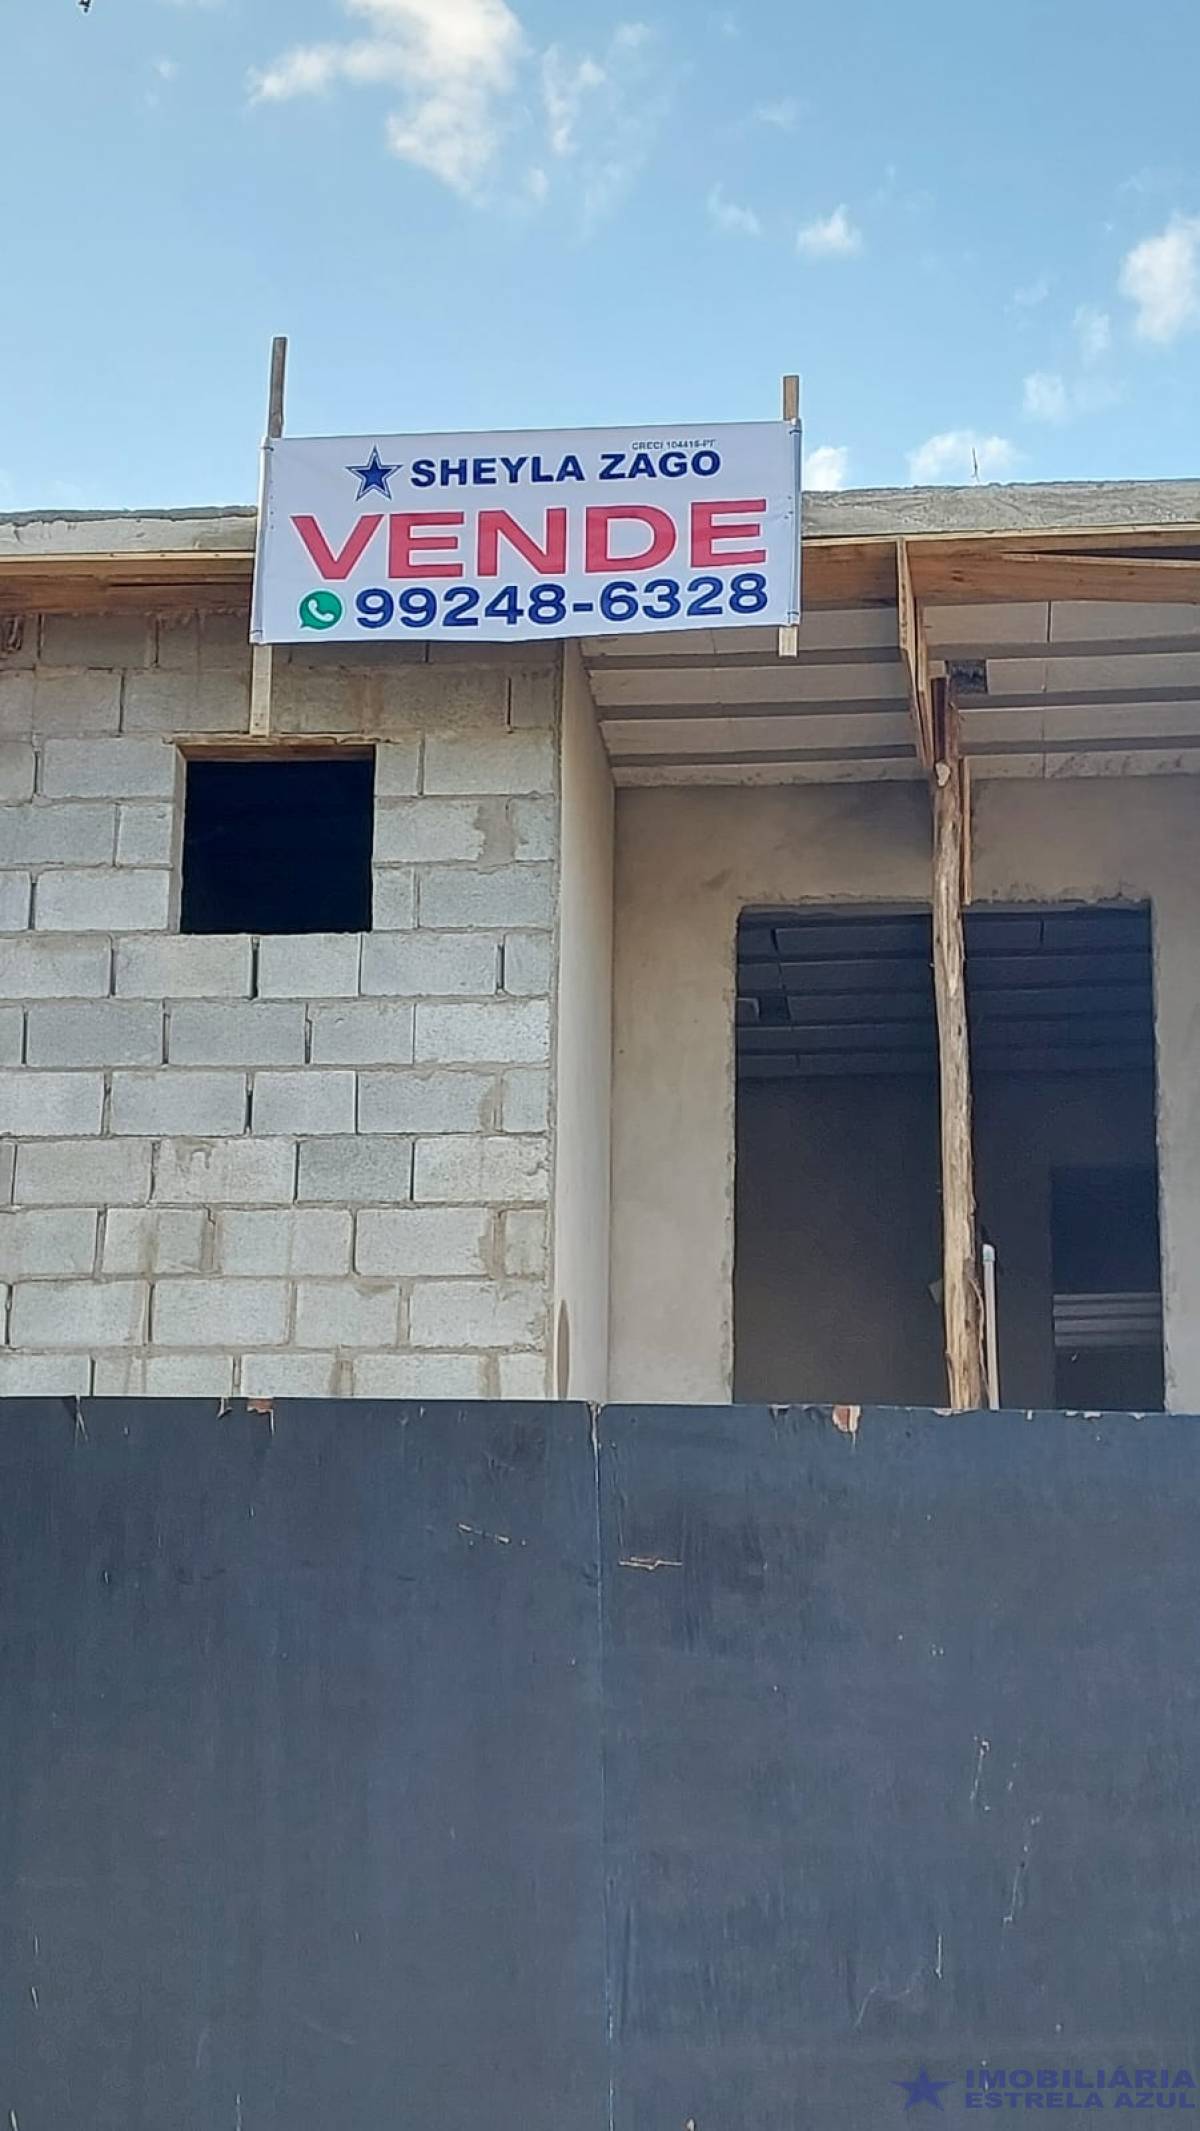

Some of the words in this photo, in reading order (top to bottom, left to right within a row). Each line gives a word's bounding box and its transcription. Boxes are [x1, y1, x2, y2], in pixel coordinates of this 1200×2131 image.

[410, 456, 588, 487] SHEYLA
[599, 450, 721, 480] ZAGO
[632, 441, 663, 450] CRECI
[290, 499, 767, 580] VENDE
[355, 573, 768, 628] 99248-6328
